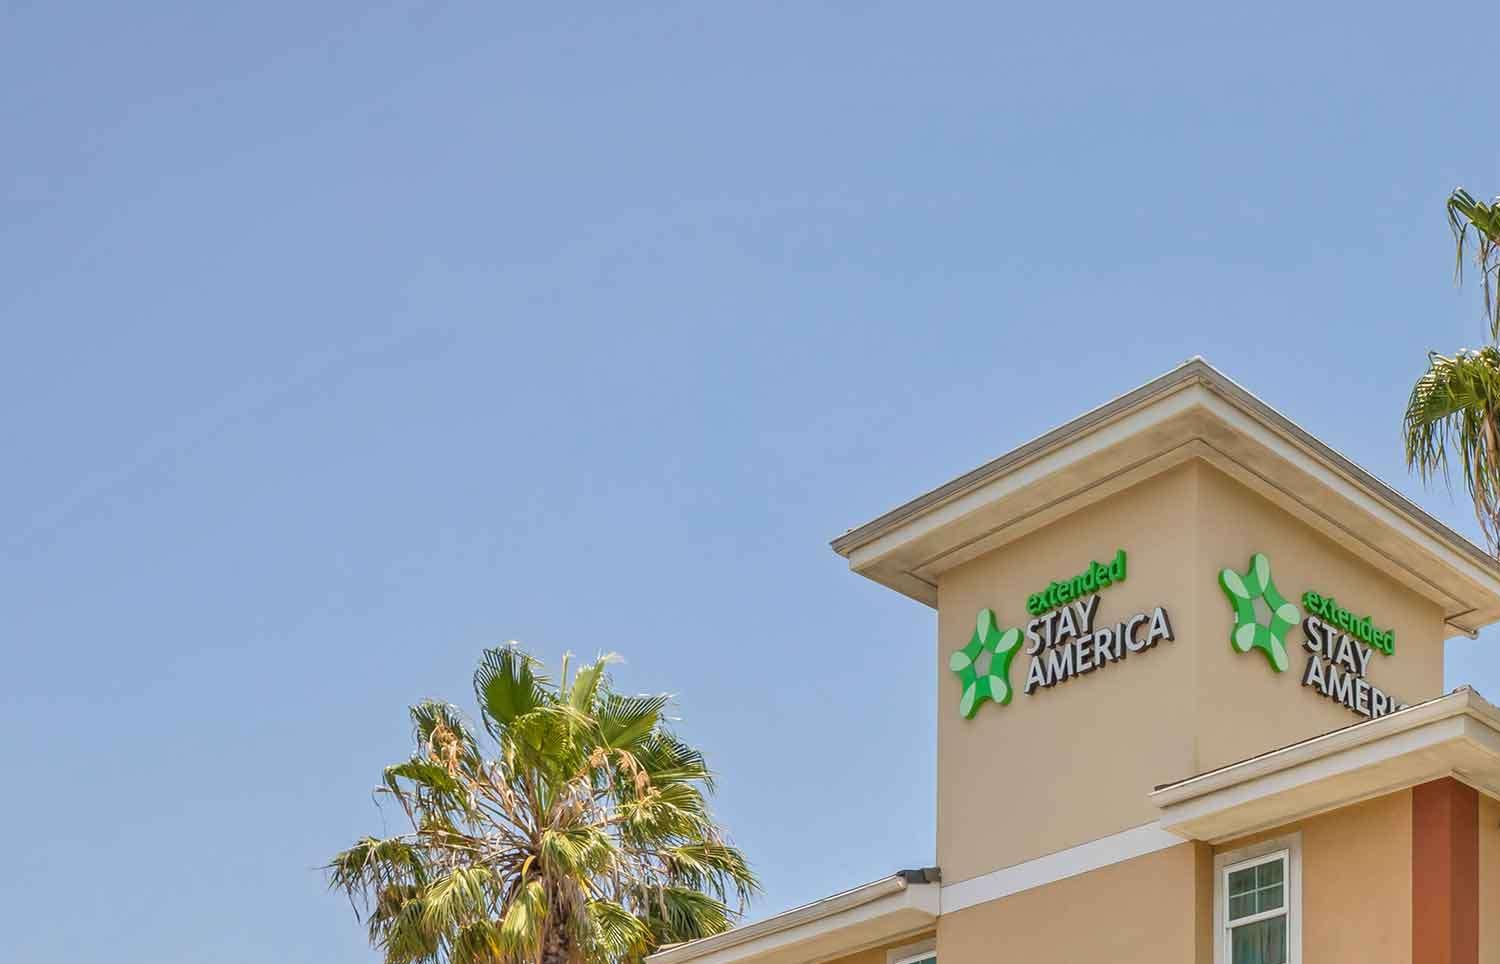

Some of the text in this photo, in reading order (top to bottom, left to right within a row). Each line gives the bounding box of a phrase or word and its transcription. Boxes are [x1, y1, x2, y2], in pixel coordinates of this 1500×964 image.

[1025, 548, 1127, 615] extended
[1024, 607, 1174, 695] AMERICA
[1026, 594, 1100, 656] STAY
[1302, 591, 1396, 656] extended
[1303, 615, 1372, 678] STAY
[1302, 655, 1408, 719] AMERI
